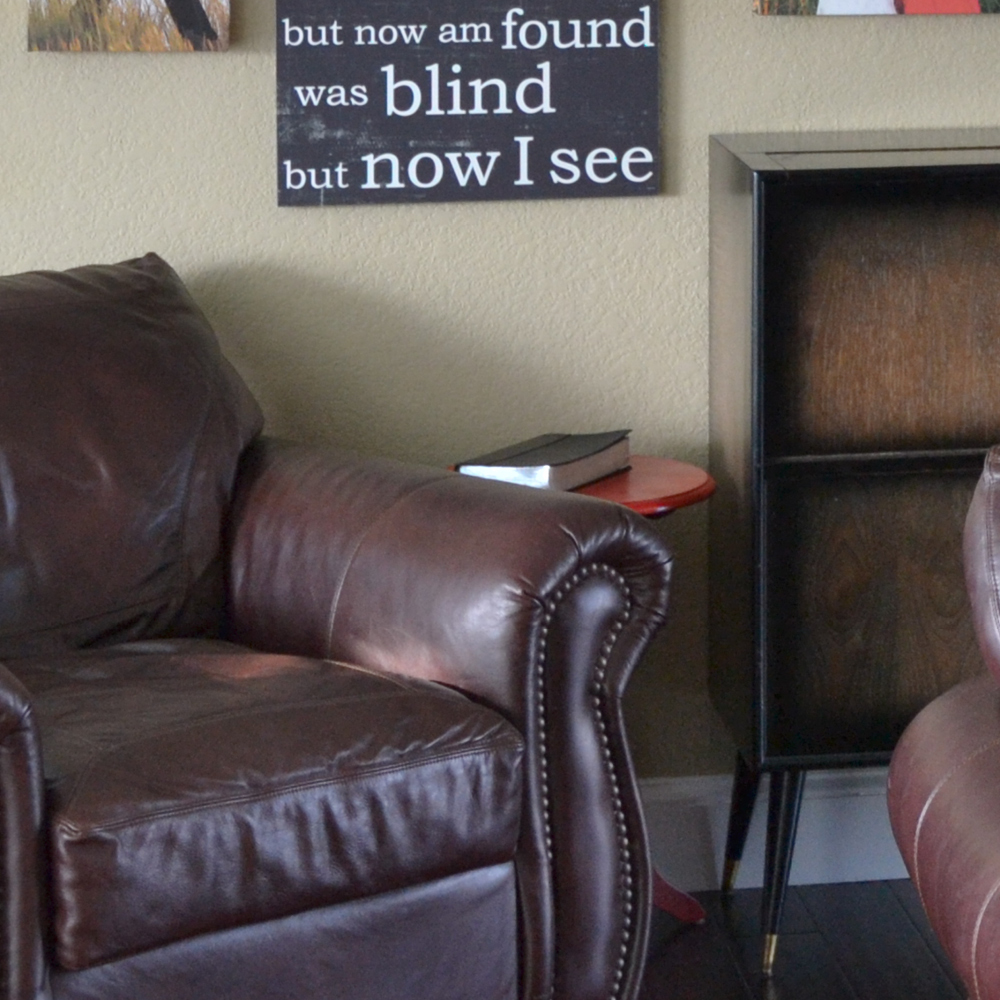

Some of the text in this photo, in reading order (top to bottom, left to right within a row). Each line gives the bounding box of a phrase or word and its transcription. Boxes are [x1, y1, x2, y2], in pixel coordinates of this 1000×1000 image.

[281, 5, 656, 50] but now am found
[293, 60, 557, 117] was blind
[282, 135, 654, 190] but now I see
